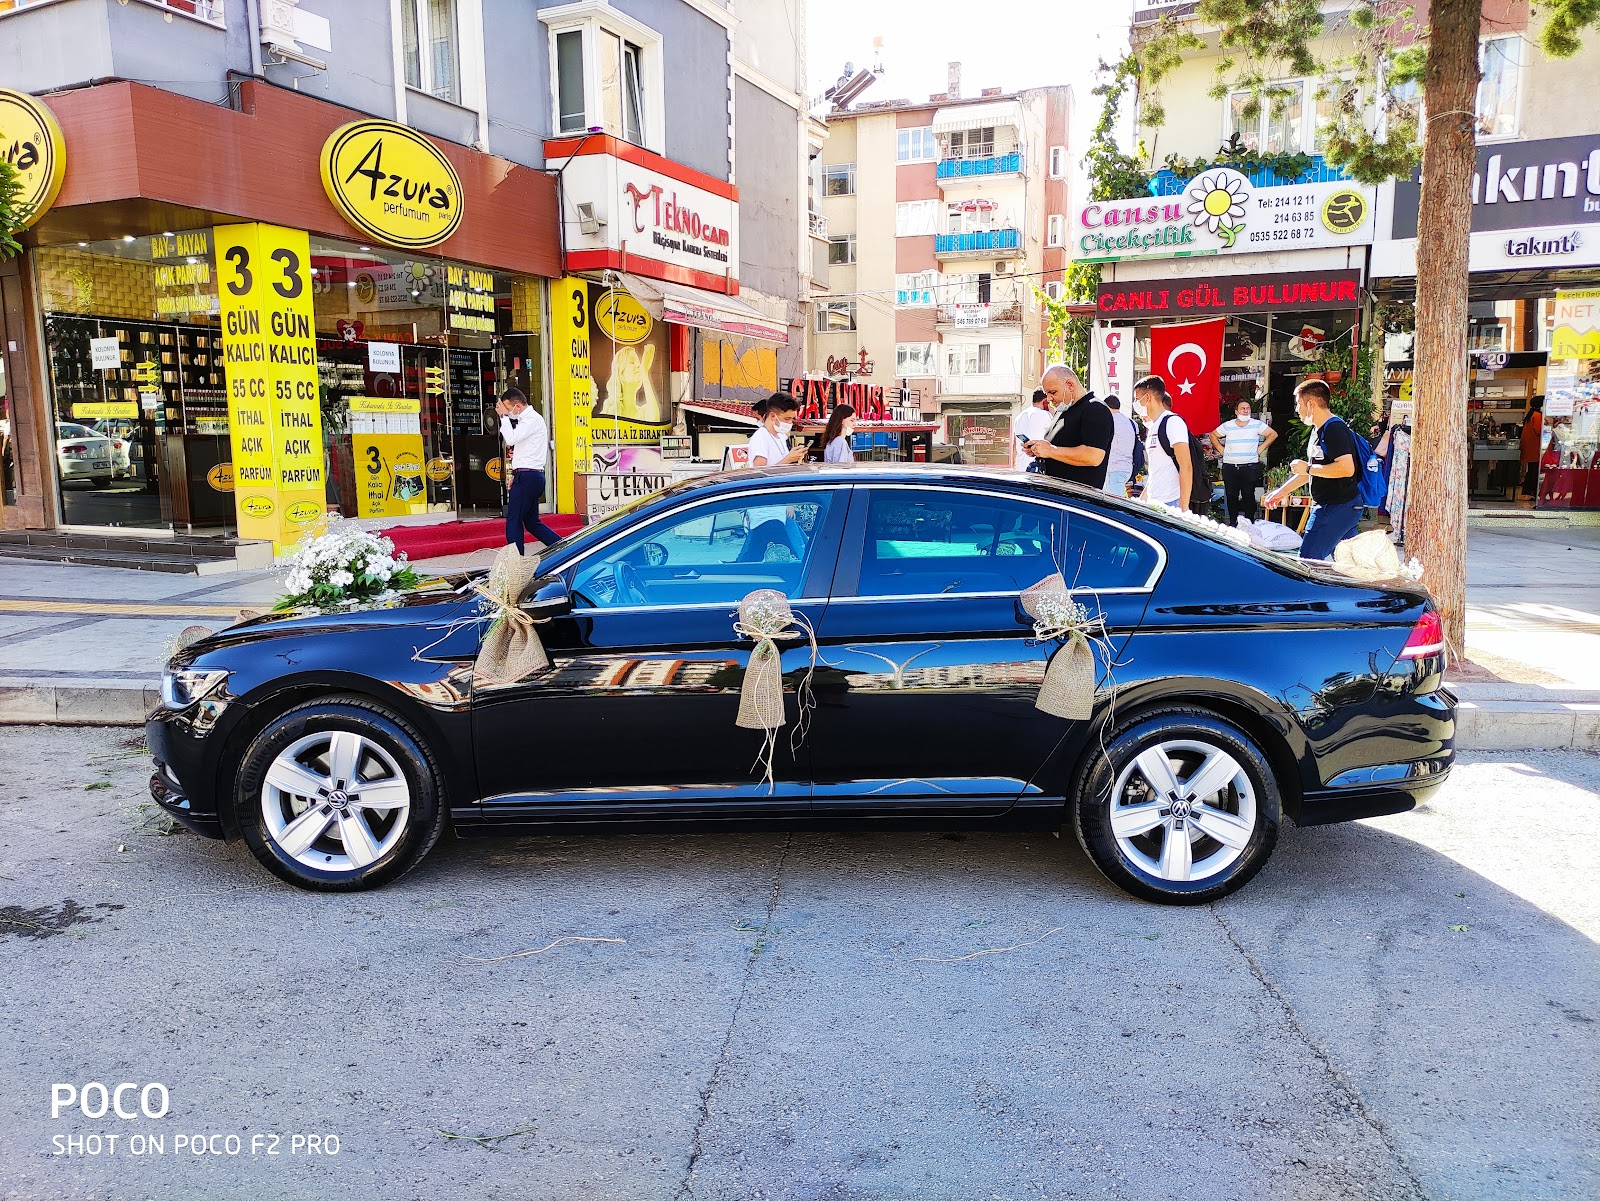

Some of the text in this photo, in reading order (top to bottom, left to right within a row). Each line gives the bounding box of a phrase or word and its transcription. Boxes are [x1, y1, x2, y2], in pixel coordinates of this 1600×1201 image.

[345, 138, 450, 210] Azura
[1472, 150, 1600, 205] kınt
[384, 202, 430, 223] perfumum
[1081, 202, 1184, 230] Cansu
[1258, 198, 1274, 209] Tel:
[1275, 197, 1290, 208] 214
[1292, 196, 1303, 207] 12
[1304, 195, 1315, 206] 11
[1274, 211, 1315, 224] 214 63 85
[152, 233, 208, 258] BAY BAYAN
[1080, 222, 1315, 256] Çiçekçilik 0535 522 68 72
[155, 261, 210, 292] AÇIK PARFÜM
[225, 246, 252, 296] 3
[270, 248, 304, 299] 3
[448, 266, 494, 292] BAY BAYAN
[449, 289, 495, 313] AÇIK PARFÜM
[1098, 280, 1356, 312] CANLI GÜL BULUNUR
[572, 290, 586, 328] 3
[602, 297, 646, 325] Azura
[1560, 304, 1594, 318] NET
[226, 306, 260, 336] GÜN
[271, 308, 311, 339] GÜN
[226, 342, 266, 362] KALICI
[269, 344, 316, 366] KALICI
[572, 335, 588, 358] GÜN
[571, 364, 590, 380] KALICI
[232, 378, 266, 398] 55 CC
[276, 380, 314, 401] 55 CC
[574, 392, 590, 406] 55 CC
[836, 381, 892, 420] HOUSE
[237, 406, 265, 426] İTHAL
[280, 408, 314, 428] İTHAL
[630, 426, 637, 439] İZ
[242, 437, 263, 458] AÇIK
[284, 439, 312, 459] AÇIK
[366, 446, 381, 474] 3
[212, 468, 234, 482] Azu
[240, 464, 272, 480] PARFÜM
[282, 466, 320, 483] PARFÜM
[244, 499, 272, 512] Azura
[288, 505, 318, 518] Azura
